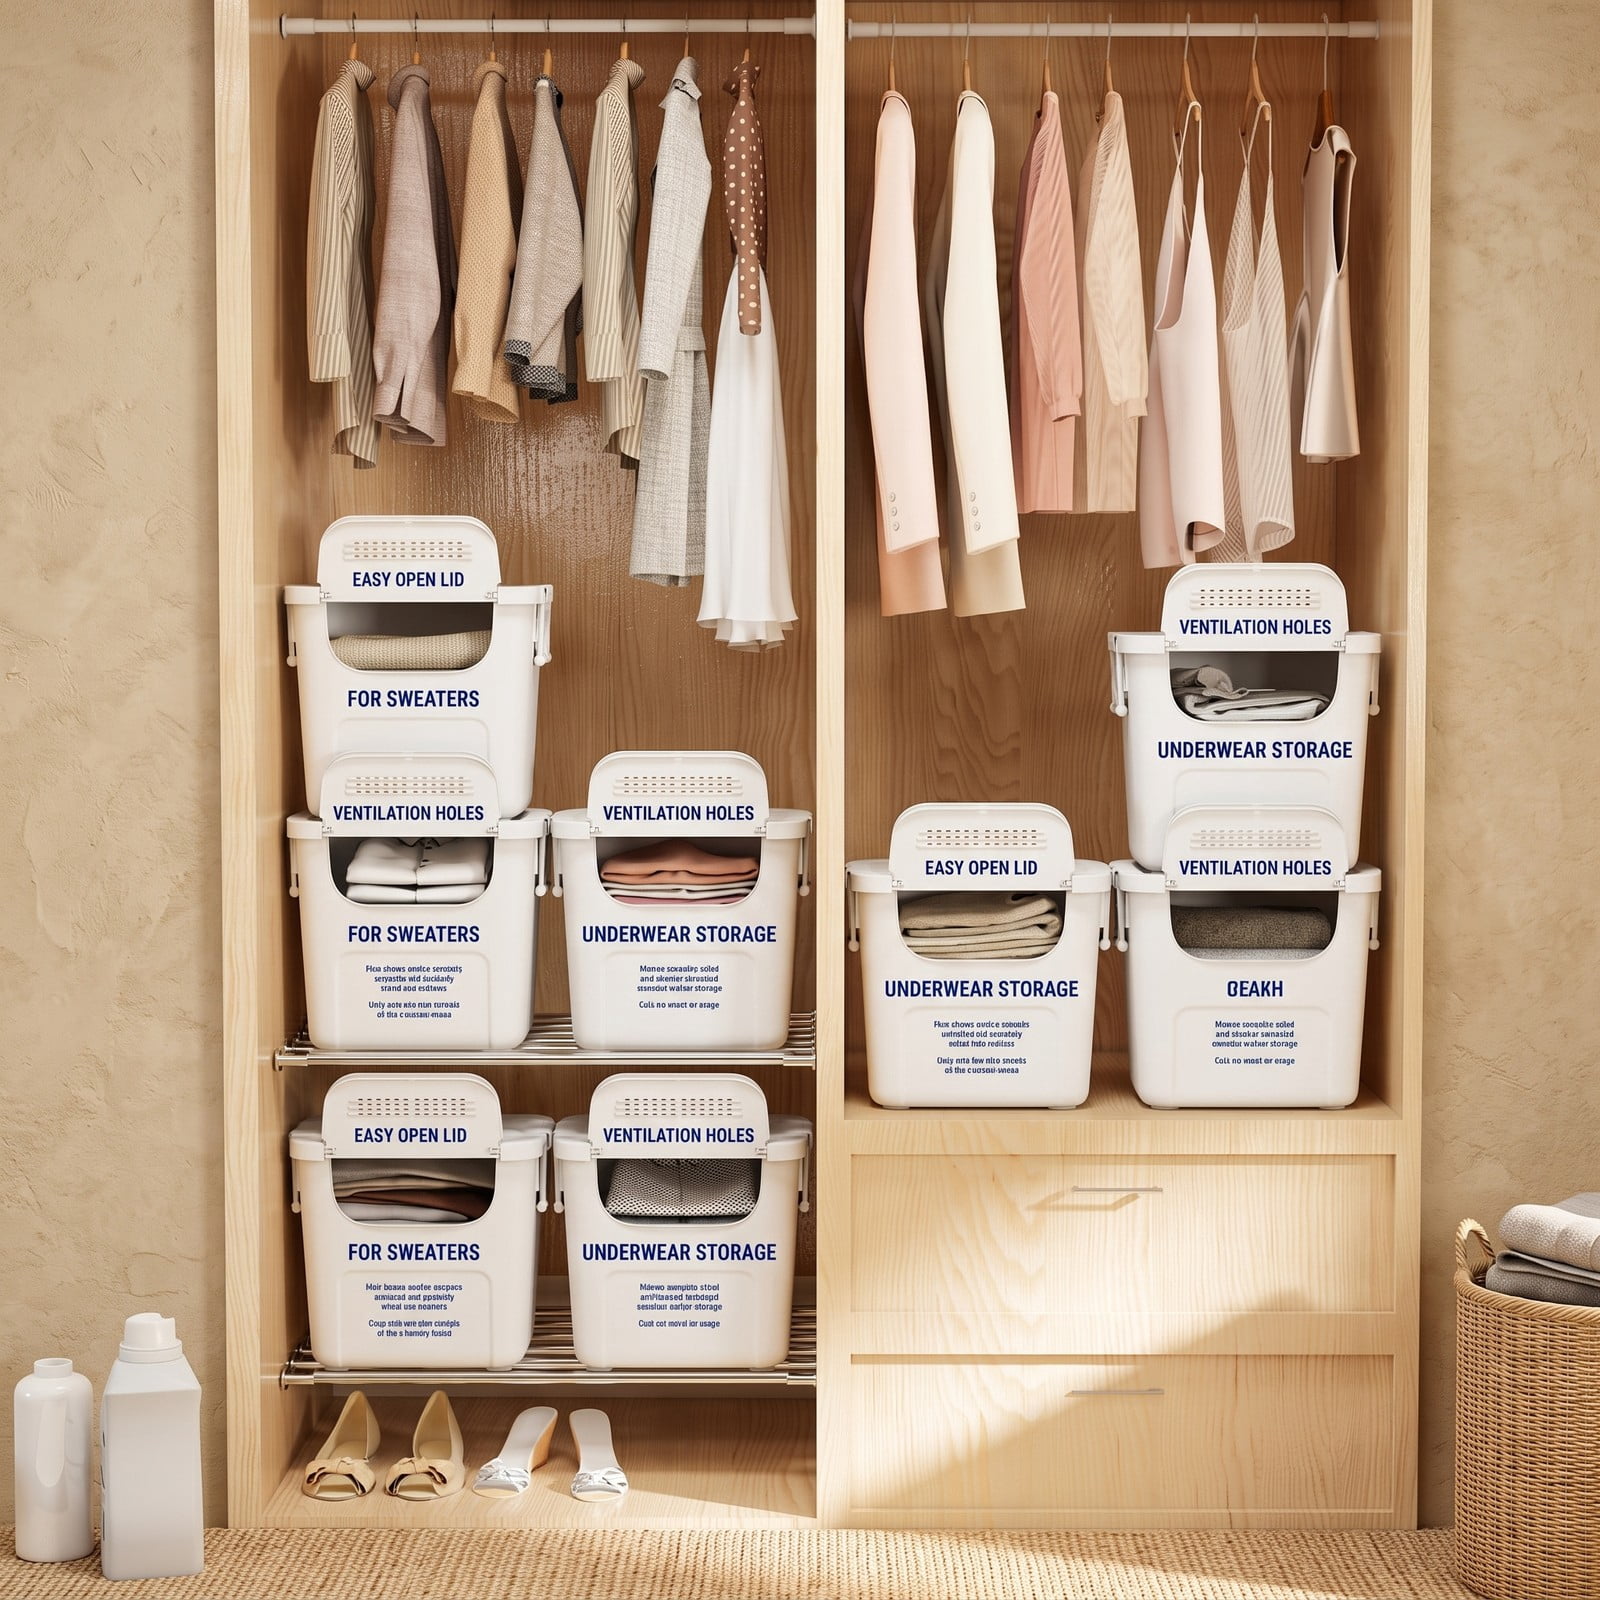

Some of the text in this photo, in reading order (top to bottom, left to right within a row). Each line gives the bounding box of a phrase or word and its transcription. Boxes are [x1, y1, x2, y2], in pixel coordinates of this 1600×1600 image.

[353, 572, 464, 587] EASY OPEN LID
[1180, 619, 1331, 634] VENTILATION HOLES
[348, 690, 479, 707] FOR SWEATERS
[1158, 741, 1351, 759] UNDERWEAR STORAGE
[334, 806, 484, 820] VENTILATION HOLES
[604, 805, 753, 821] VENTILATION HOLES
[926, 860, 1037, 875] EASY OPEN LID
[1180, 860, 1331, 875] VENTILATION HOLES
[349, 925, 479, 942] FOR SWEATERS
[583, 925, 775, 942] UNDERWEAR STORAGE
[695, 985, 722, 993] storage
[885, 980, 1077, 997] UNDERWEAR STORAGE
[1270, 1041, 1298, 1049] storage
[355, 1128, 467, 1143] EASY OPEN LID
[604, 1128, 754, 1143] VENTILATION HOLES
[349, 1243, 480, 1261] FOR SWEATERS
[583, 1243, 774, 1261] UNDERWEAR STORAGE
[694, 1303, 722, 1311] storage
[700, 1320, 720, 1328] usage
